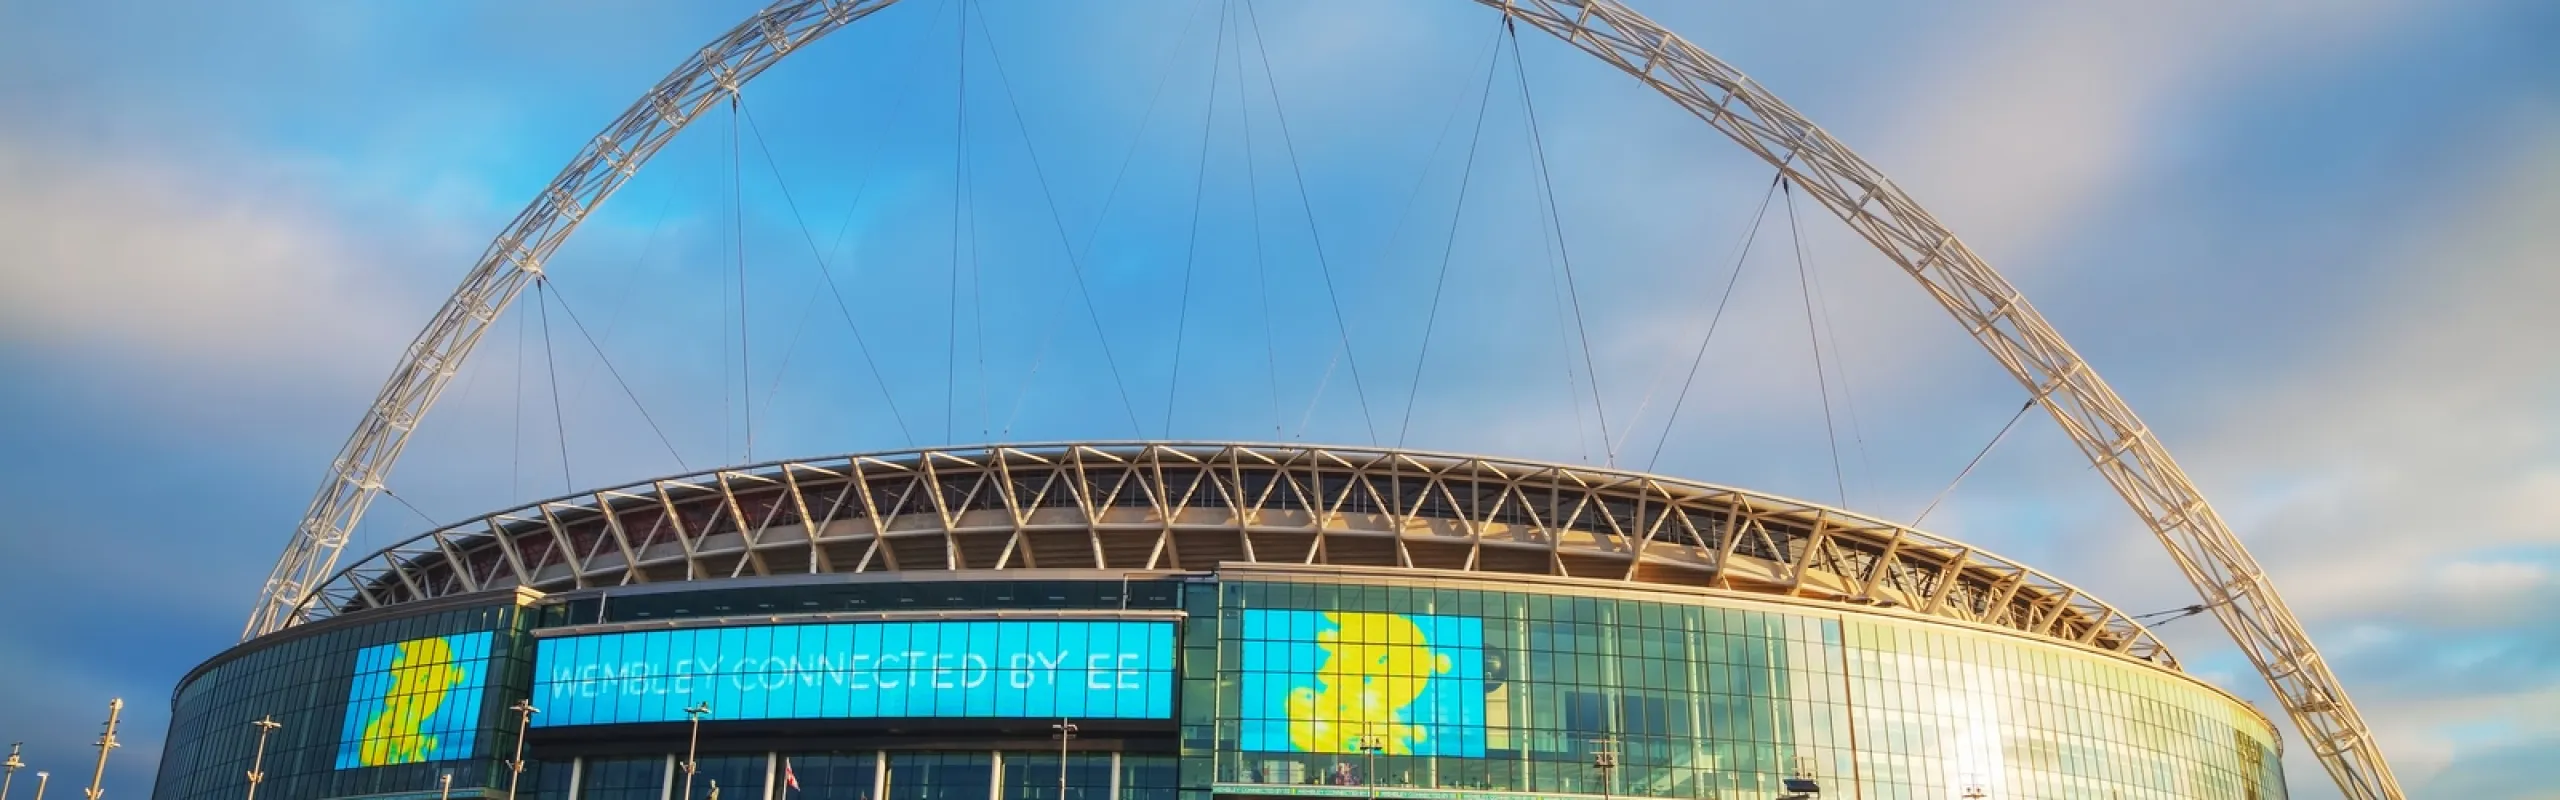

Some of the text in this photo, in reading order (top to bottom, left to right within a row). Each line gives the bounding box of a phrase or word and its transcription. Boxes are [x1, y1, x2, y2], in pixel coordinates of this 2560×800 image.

[551, 650, 1139, 699] WEMBLEY CONNECTED BY EE
